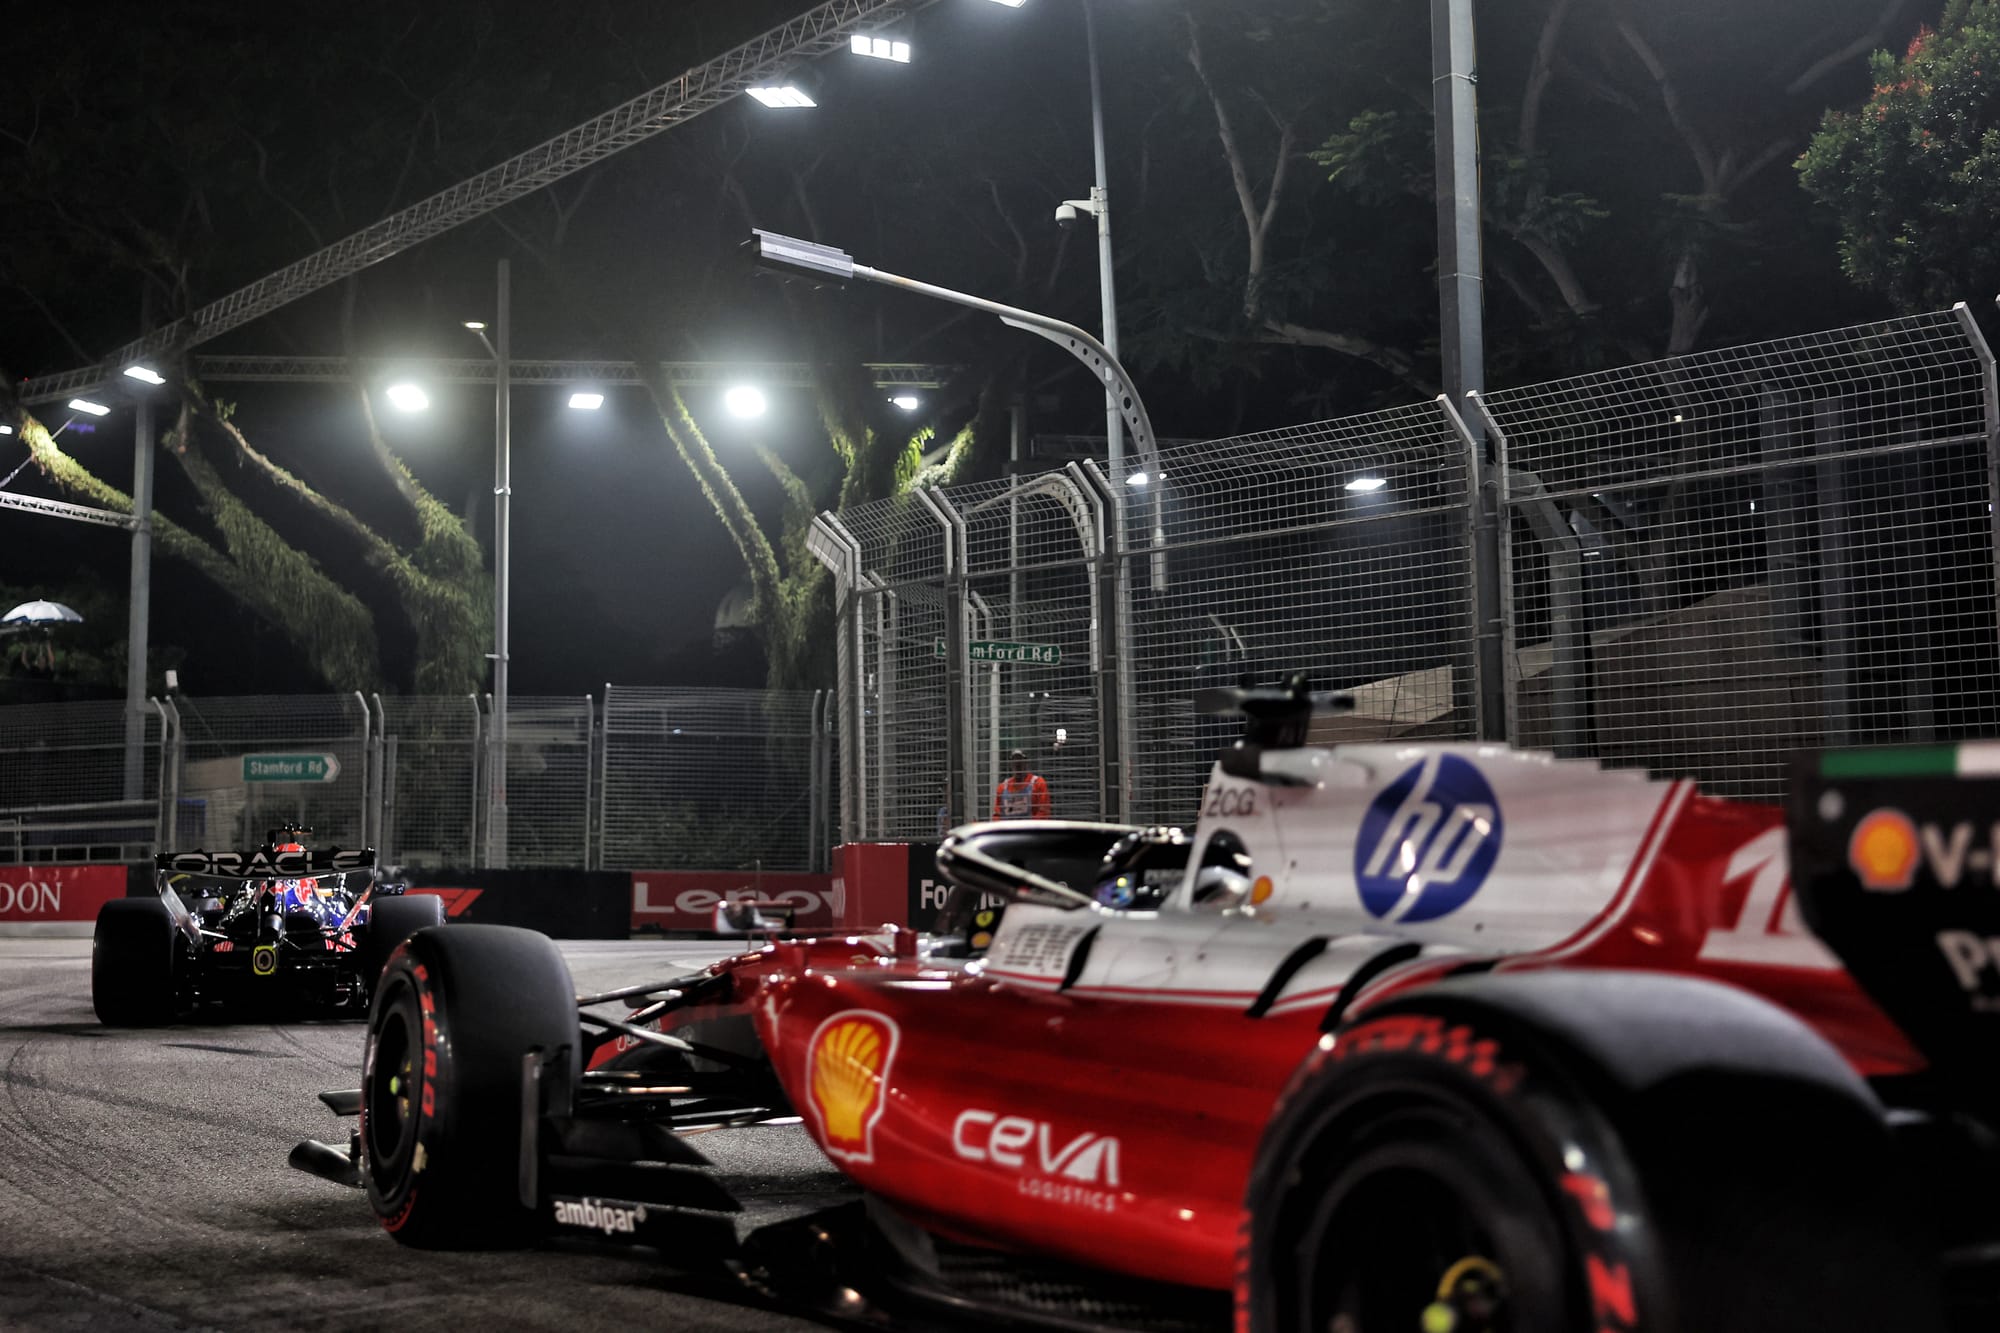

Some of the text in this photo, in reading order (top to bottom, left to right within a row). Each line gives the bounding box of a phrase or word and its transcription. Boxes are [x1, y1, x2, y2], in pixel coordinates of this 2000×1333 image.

[1032, 646, 1053, 662] Rd
[250, 760, 323, 776] Stamford Rd
[1362, 752, 1495, 922] hp
[170, 850, 361, 876] ORACLE
[1018, 1177, 1116, 1213] LOGISTICS
[554, 1197, 636, 1235] ambipar
